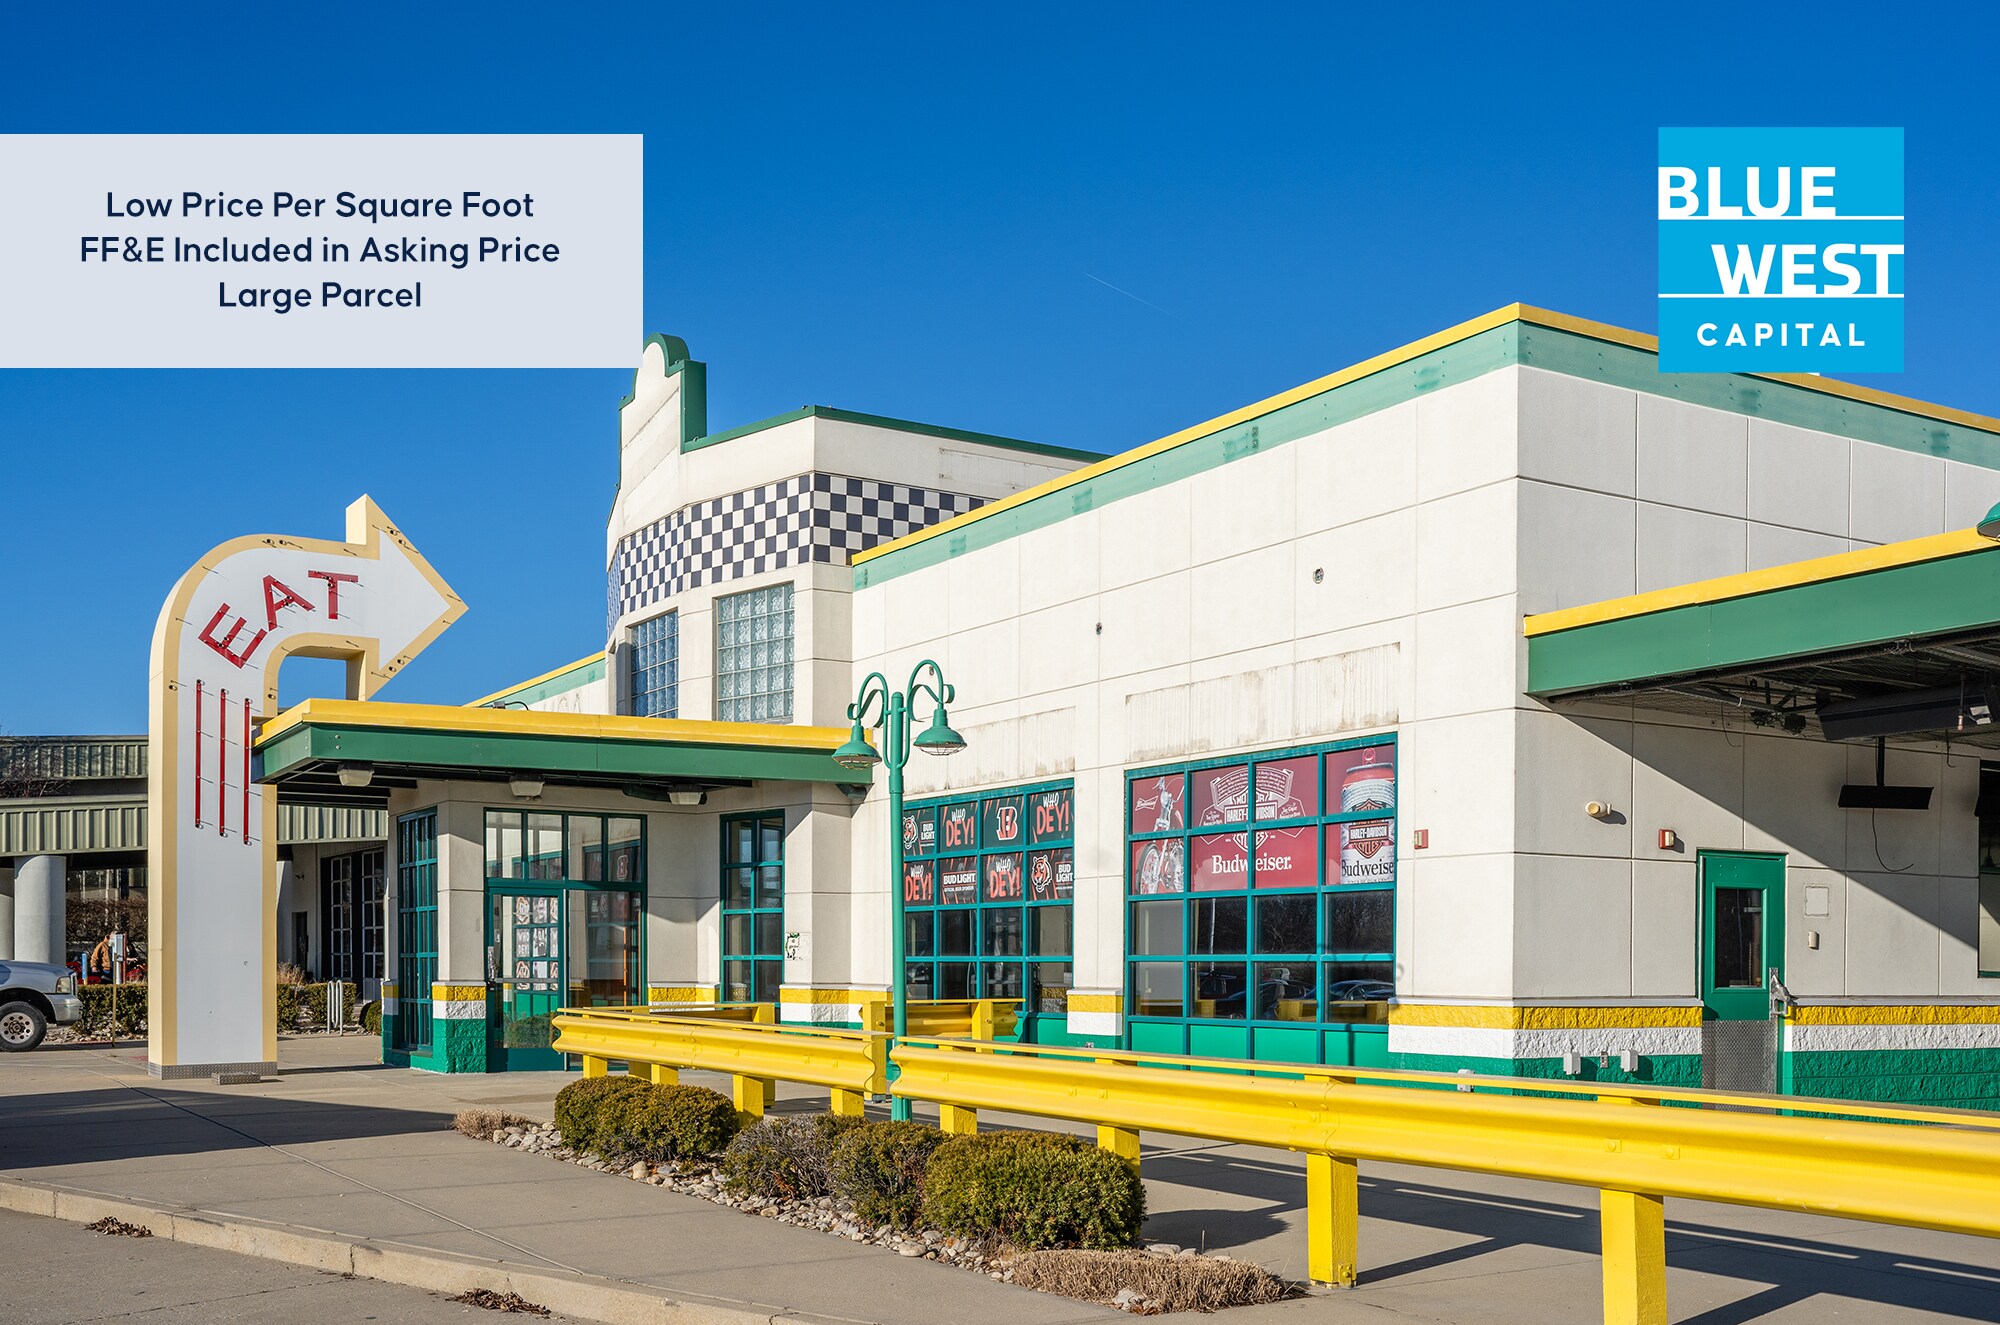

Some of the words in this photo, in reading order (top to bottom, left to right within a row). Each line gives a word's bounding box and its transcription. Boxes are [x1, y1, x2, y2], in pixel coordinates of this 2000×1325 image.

[197, 569, 359, 669] EAT
[923, 823, 934, 832] BUD
[946, 816, 974, 848] DEY!
[1036, 800, 1069, 835] DEY!
[944, 875, 957, 885] BUD
[957, 873, 976, 884] LIGHT
[990, 867, 1020, 899] DEY!
[1056, 873, 1073, 883] LIGHT
[1058, 864, 1071, 873] BUD
[905, 873, 932, 902] DEY!
